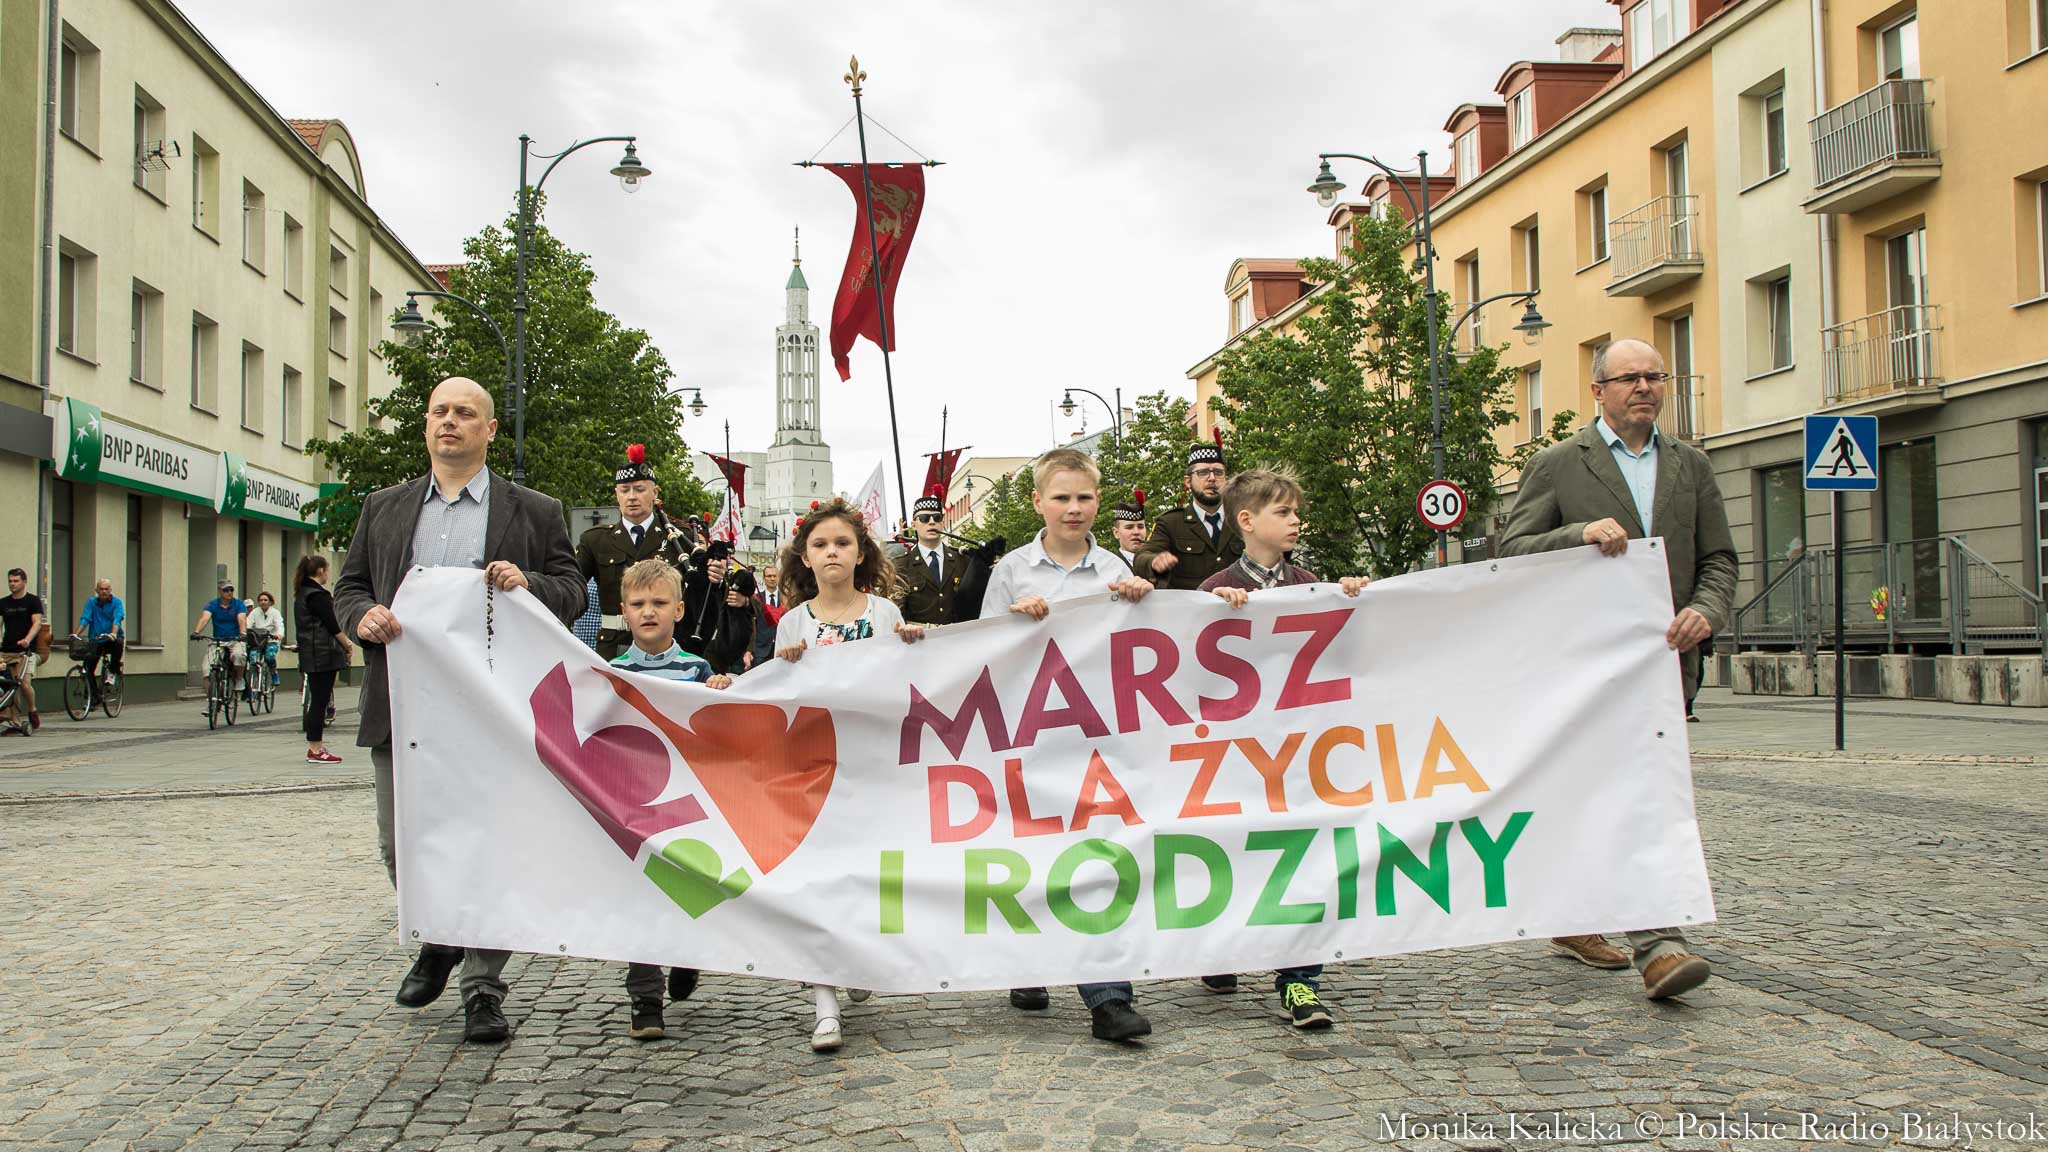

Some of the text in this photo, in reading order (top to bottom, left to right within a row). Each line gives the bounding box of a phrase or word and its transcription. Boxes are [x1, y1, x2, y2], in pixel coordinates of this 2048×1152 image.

[103, 433, 188, 481] BNP PARIBAS
[246, 478, 300, 511] BNP PARIBAS
[1426, 494, 1458, 516] 30
[899, 608, 1355, 765] MARSZ
[928, 716, 1491, 843] DLA ŻYCIA
[879, 811, 1534, 935] I RODZINY
